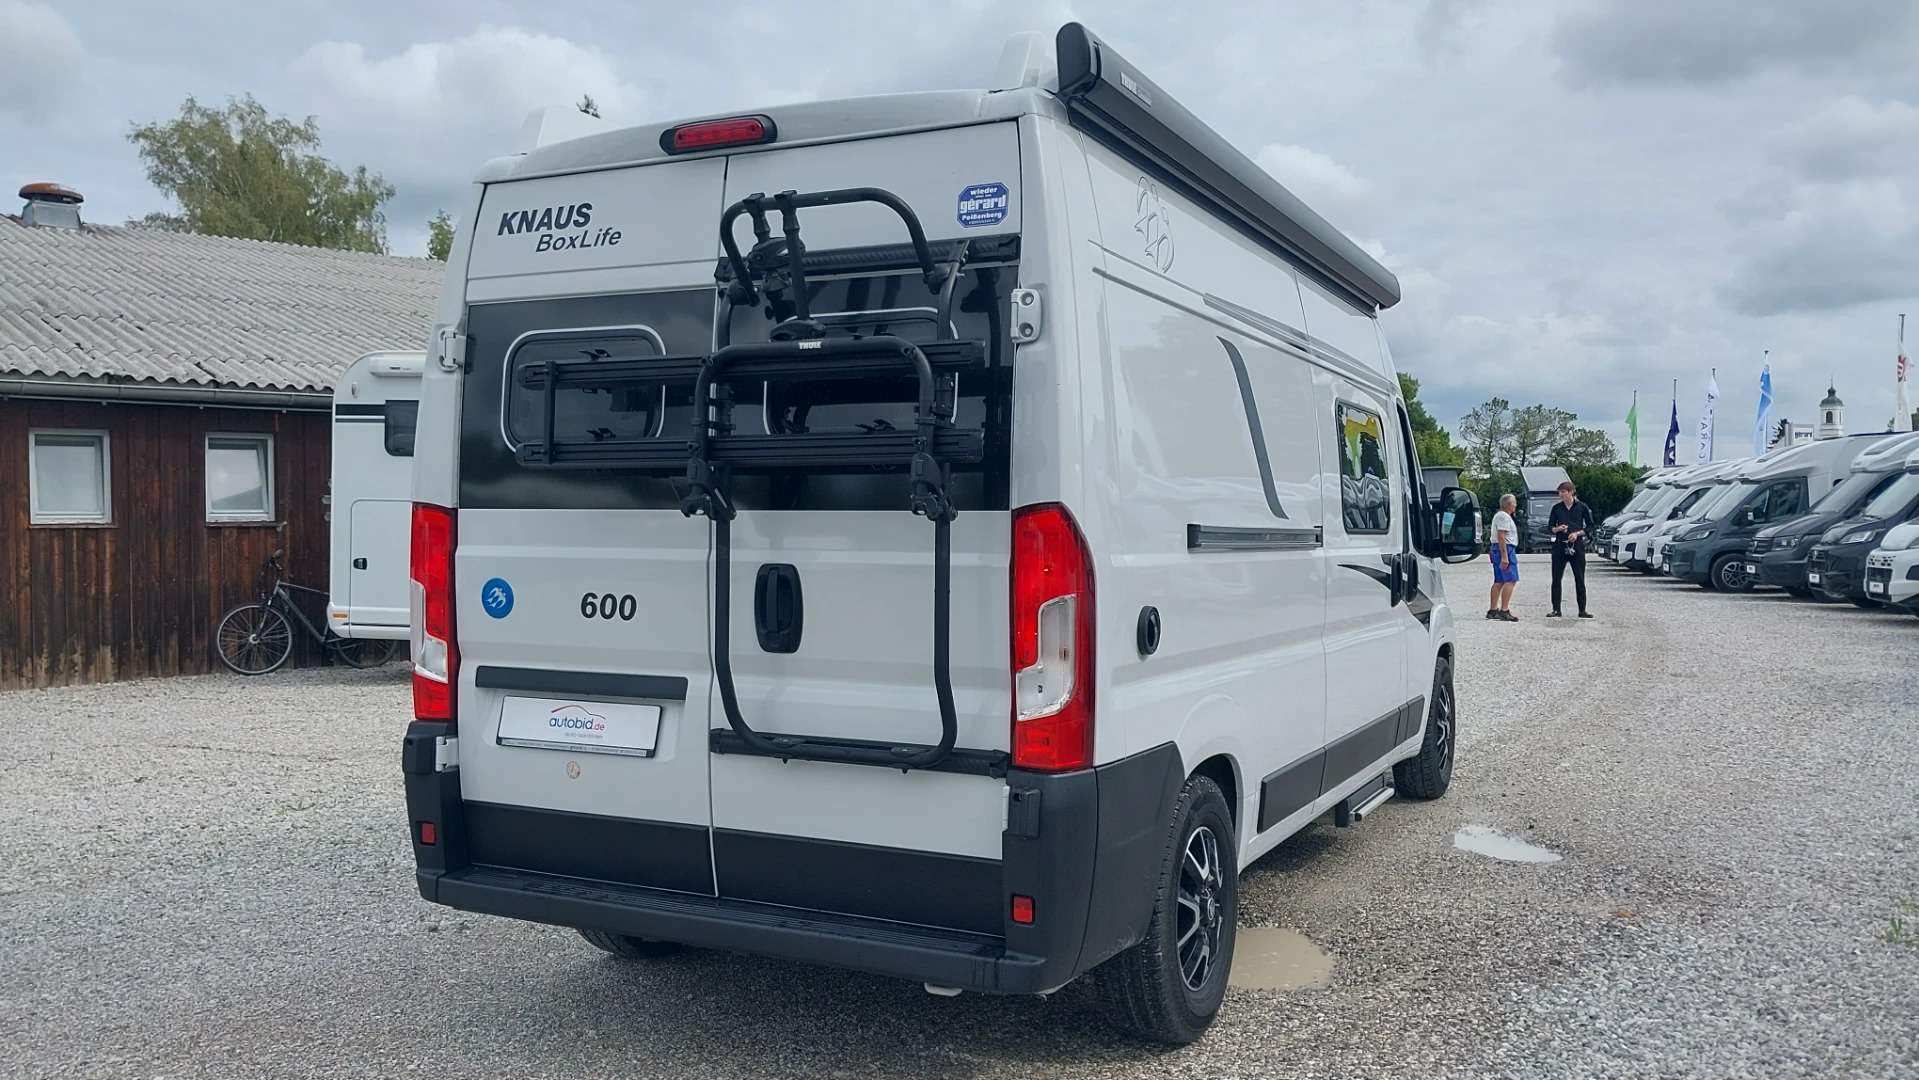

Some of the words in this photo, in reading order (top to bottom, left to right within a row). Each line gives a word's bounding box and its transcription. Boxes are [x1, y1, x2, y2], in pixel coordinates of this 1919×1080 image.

[970, 187, 998, 195] wieder
[497, 203, 593, 236] KNAUS
[536, 227, 622, 252] BoxLife
[581, 592, 637, 621] 600
[549, 715, 605, 731] autobid.de
